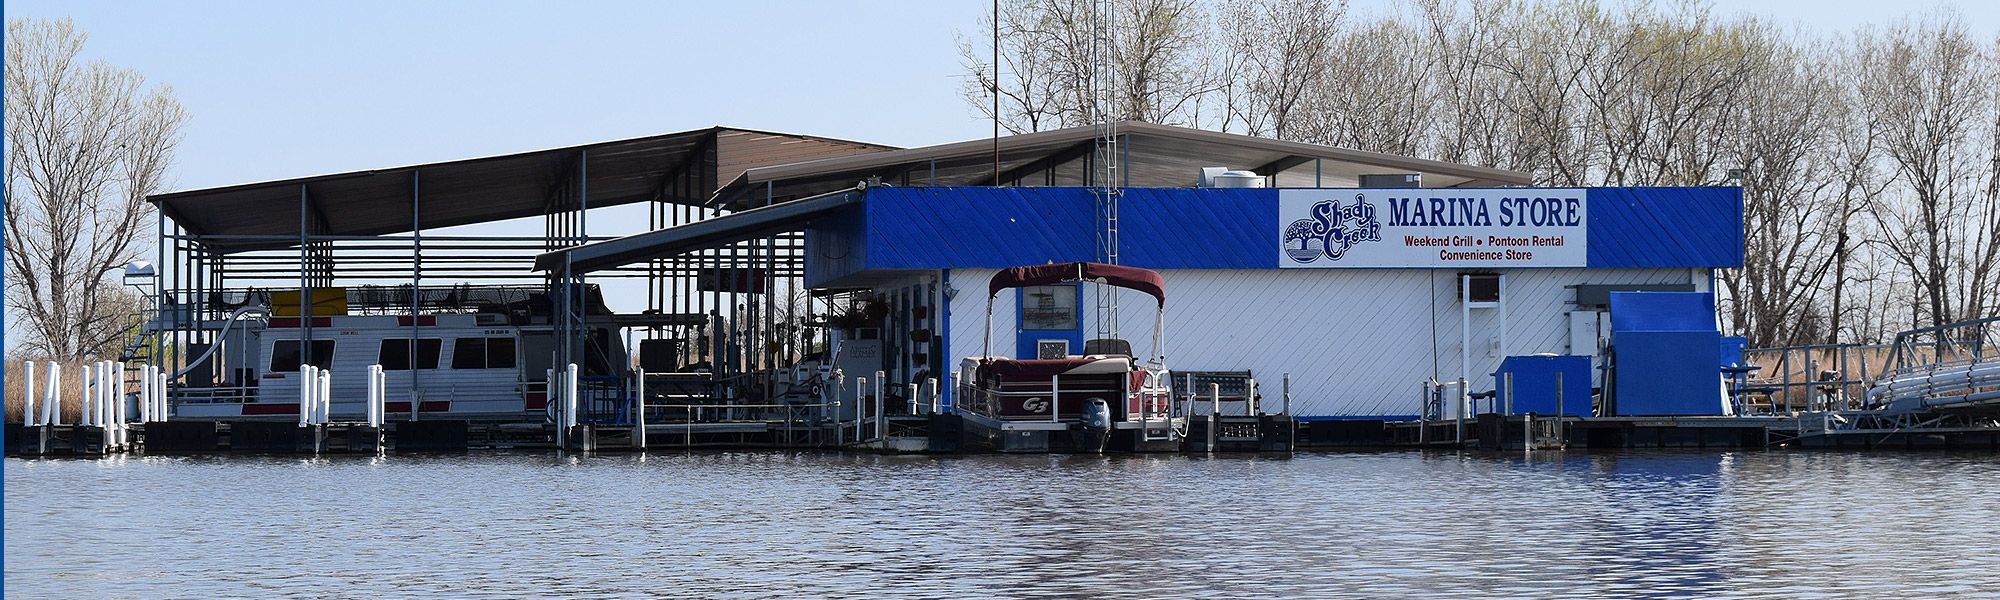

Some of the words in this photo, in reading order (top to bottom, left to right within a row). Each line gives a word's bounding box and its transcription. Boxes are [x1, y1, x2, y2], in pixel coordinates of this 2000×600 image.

[1311, 195, 1374, 235] Shady
[1388, 197, 1492, 227] MARINA
[1499, 196, 1581, 227] STORE
[1323, 217, 1380, 259] Creek
[1404, 235, 1449, 247] Weekend
[1453, 235, 1473, 247] Grill
[1488, 235, 1529, 247] Pontoon
[1532, 235, 1564, 247] Rental
[1439, 249, 1503, 260] Convenience
[1505, 249, 1533, 260] Store
[1022, 397, 1049, 413] G3
